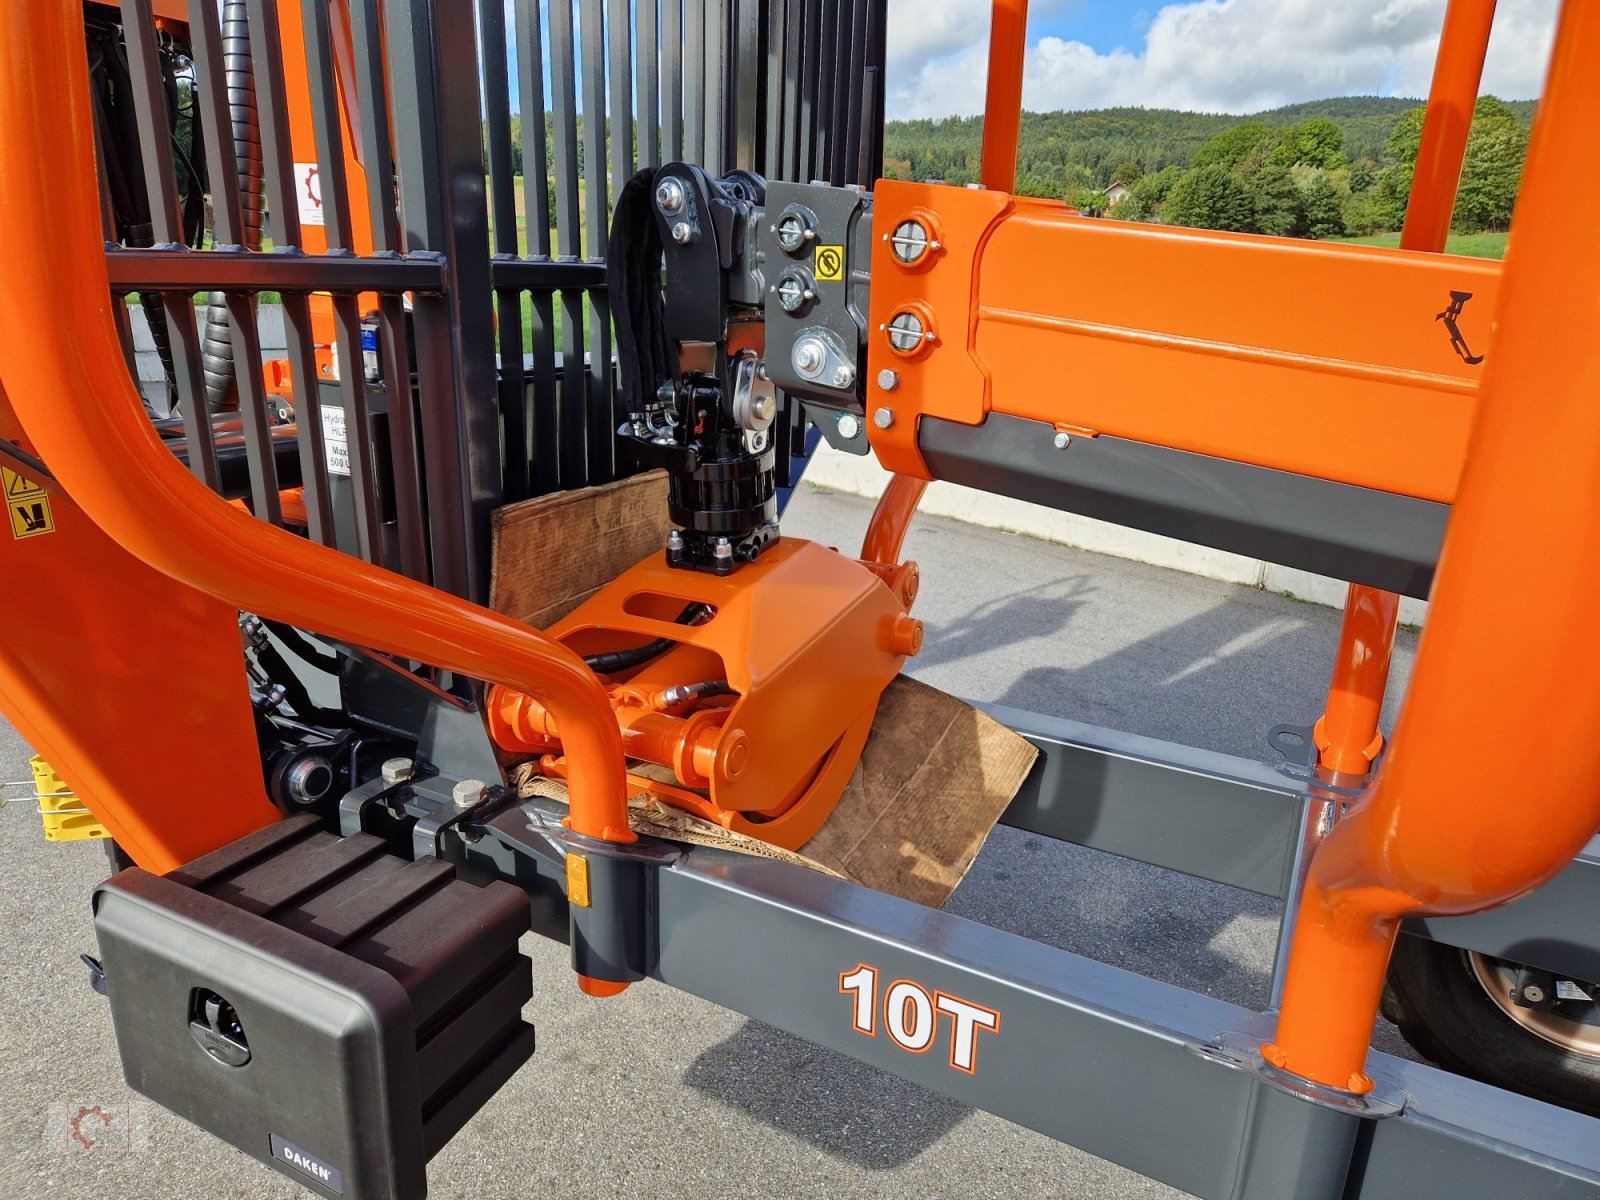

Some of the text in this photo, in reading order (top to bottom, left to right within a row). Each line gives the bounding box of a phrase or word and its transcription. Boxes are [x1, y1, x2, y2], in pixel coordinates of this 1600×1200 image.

[330, 457, 344, 468] 500
[839, 962, 1001, 1076] 10T
[283, 1146, 329, 1181] DAKEN
